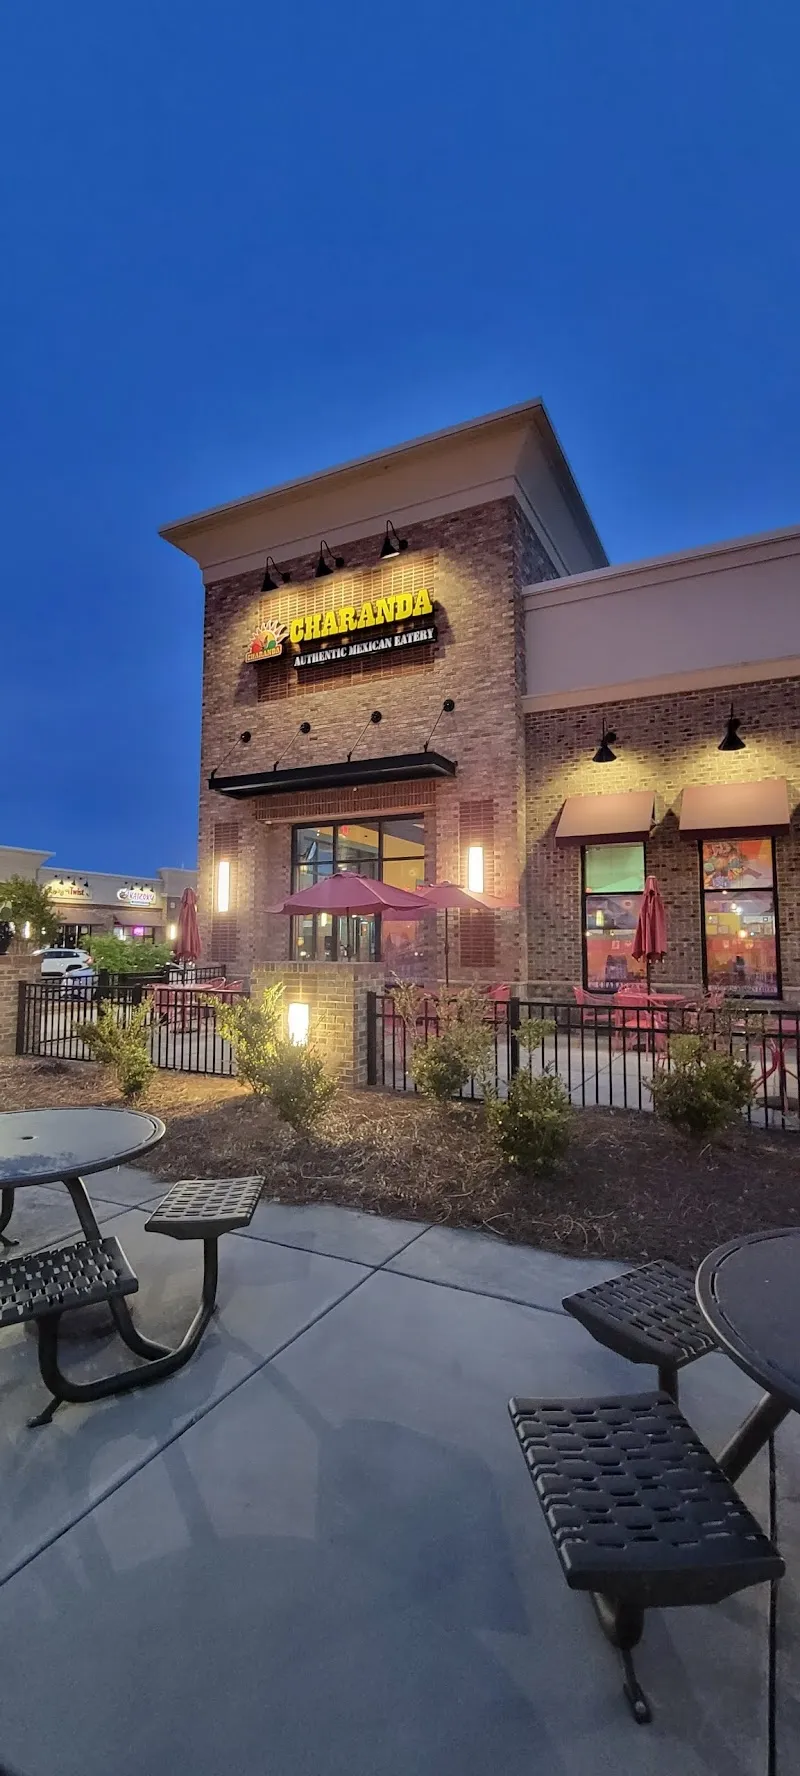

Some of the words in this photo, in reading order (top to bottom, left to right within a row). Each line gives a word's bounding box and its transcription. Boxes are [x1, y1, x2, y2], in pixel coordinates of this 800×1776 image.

[289, 588, 433, 643] CHARANDA
[294, 646, 348, 667] AUTHENTIC
[348, 637, 393, 656] MEXICAN
[394, 628, 435, 646] EATERY
